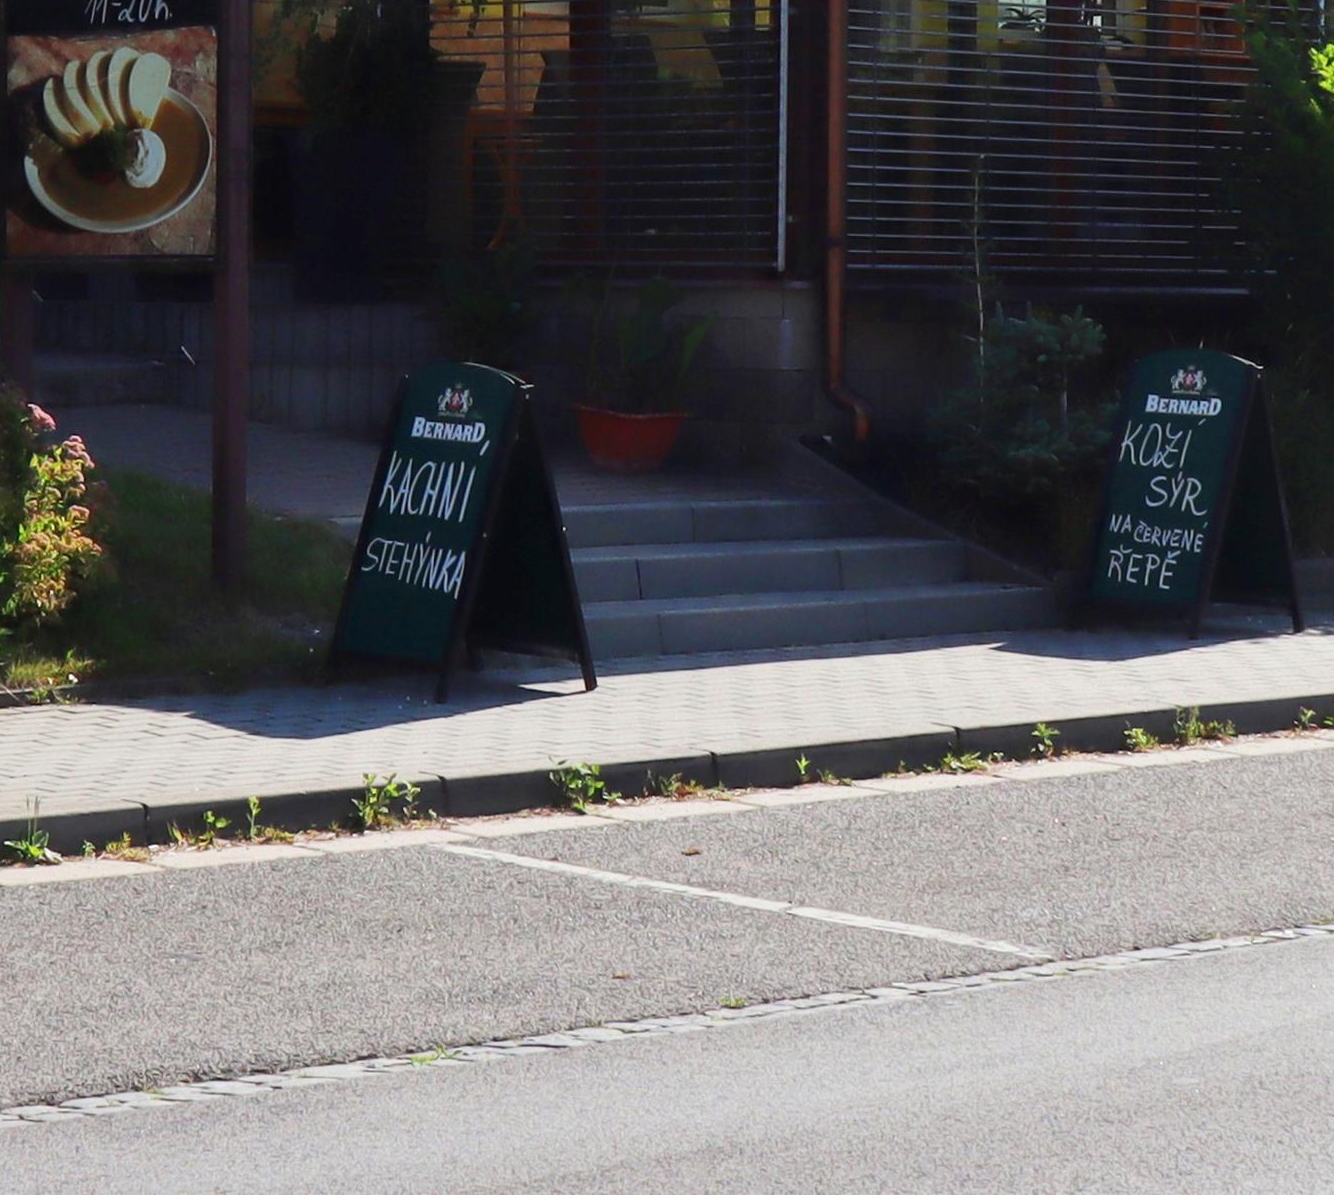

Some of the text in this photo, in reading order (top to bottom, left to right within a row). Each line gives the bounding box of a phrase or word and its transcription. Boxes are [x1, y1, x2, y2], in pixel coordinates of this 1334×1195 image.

[1144, 393, 1223, 417] BERNARD
[411, 416, 486, 443] BERNARD
[378, 439, 491, 523] KACHNÍ
[1144, 471, 1208, 517] SÝR
[1109, 513, 1209, 554] NA ČERVENÉ
[360, 531, 467, 600] STEHÝNKA
[1107, 544, 1182, 590] ŘEPĚ
